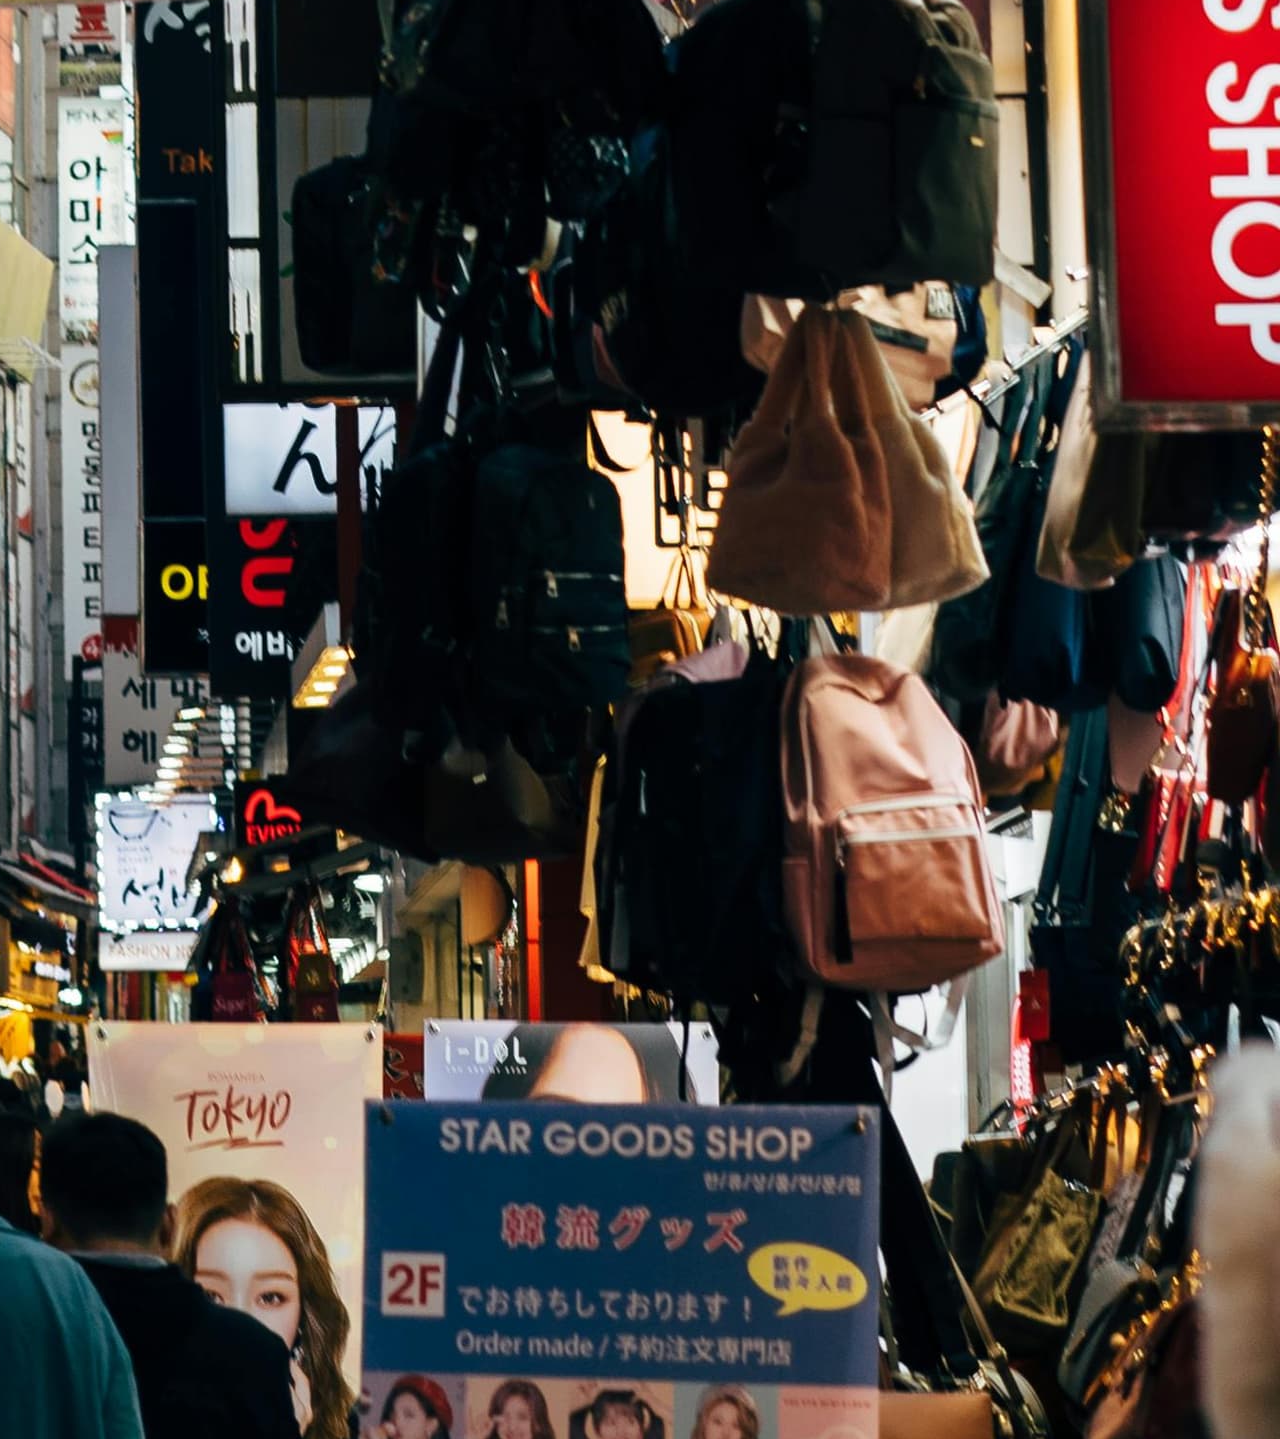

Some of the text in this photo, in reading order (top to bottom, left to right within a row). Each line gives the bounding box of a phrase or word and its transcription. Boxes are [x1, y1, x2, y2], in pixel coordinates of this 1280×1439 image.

[1205, 61, 1280, 365] SHOP
[440, 1117, 813, 1163] STAR GOODS SHOP
[501, 1201, 748, 1254] 韓流グッズ
[387, 1262, 443, 1308] 2F
[456, 1329, 524, 1358] Order
[529, 1332, 594, 1359] made
